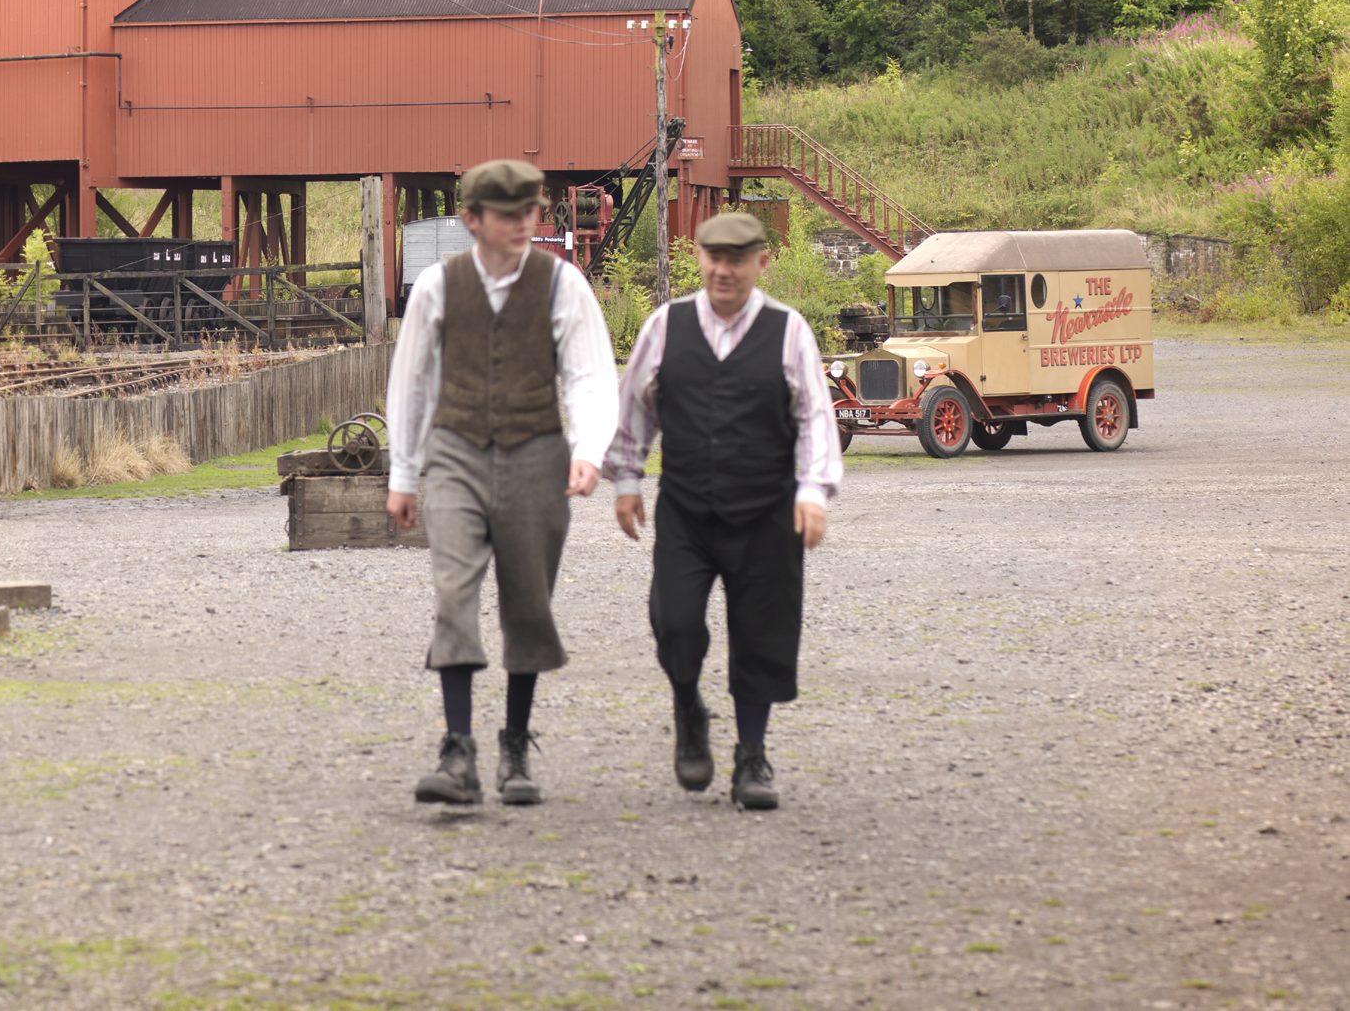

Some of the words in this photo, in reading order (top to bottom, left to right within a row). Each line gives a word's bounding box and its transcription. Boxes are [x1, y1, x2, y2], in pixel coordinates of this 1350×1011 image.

[446, 218, 456, 227] 18
[1085, 277, 1112, 296] THE
[1046, 287, 1133, 344] Newcastle
[1040, 346, 1116, 367] BREWERIES
[839, 409, 854, 418] NBA
[855, 409, 867, 418] 517
